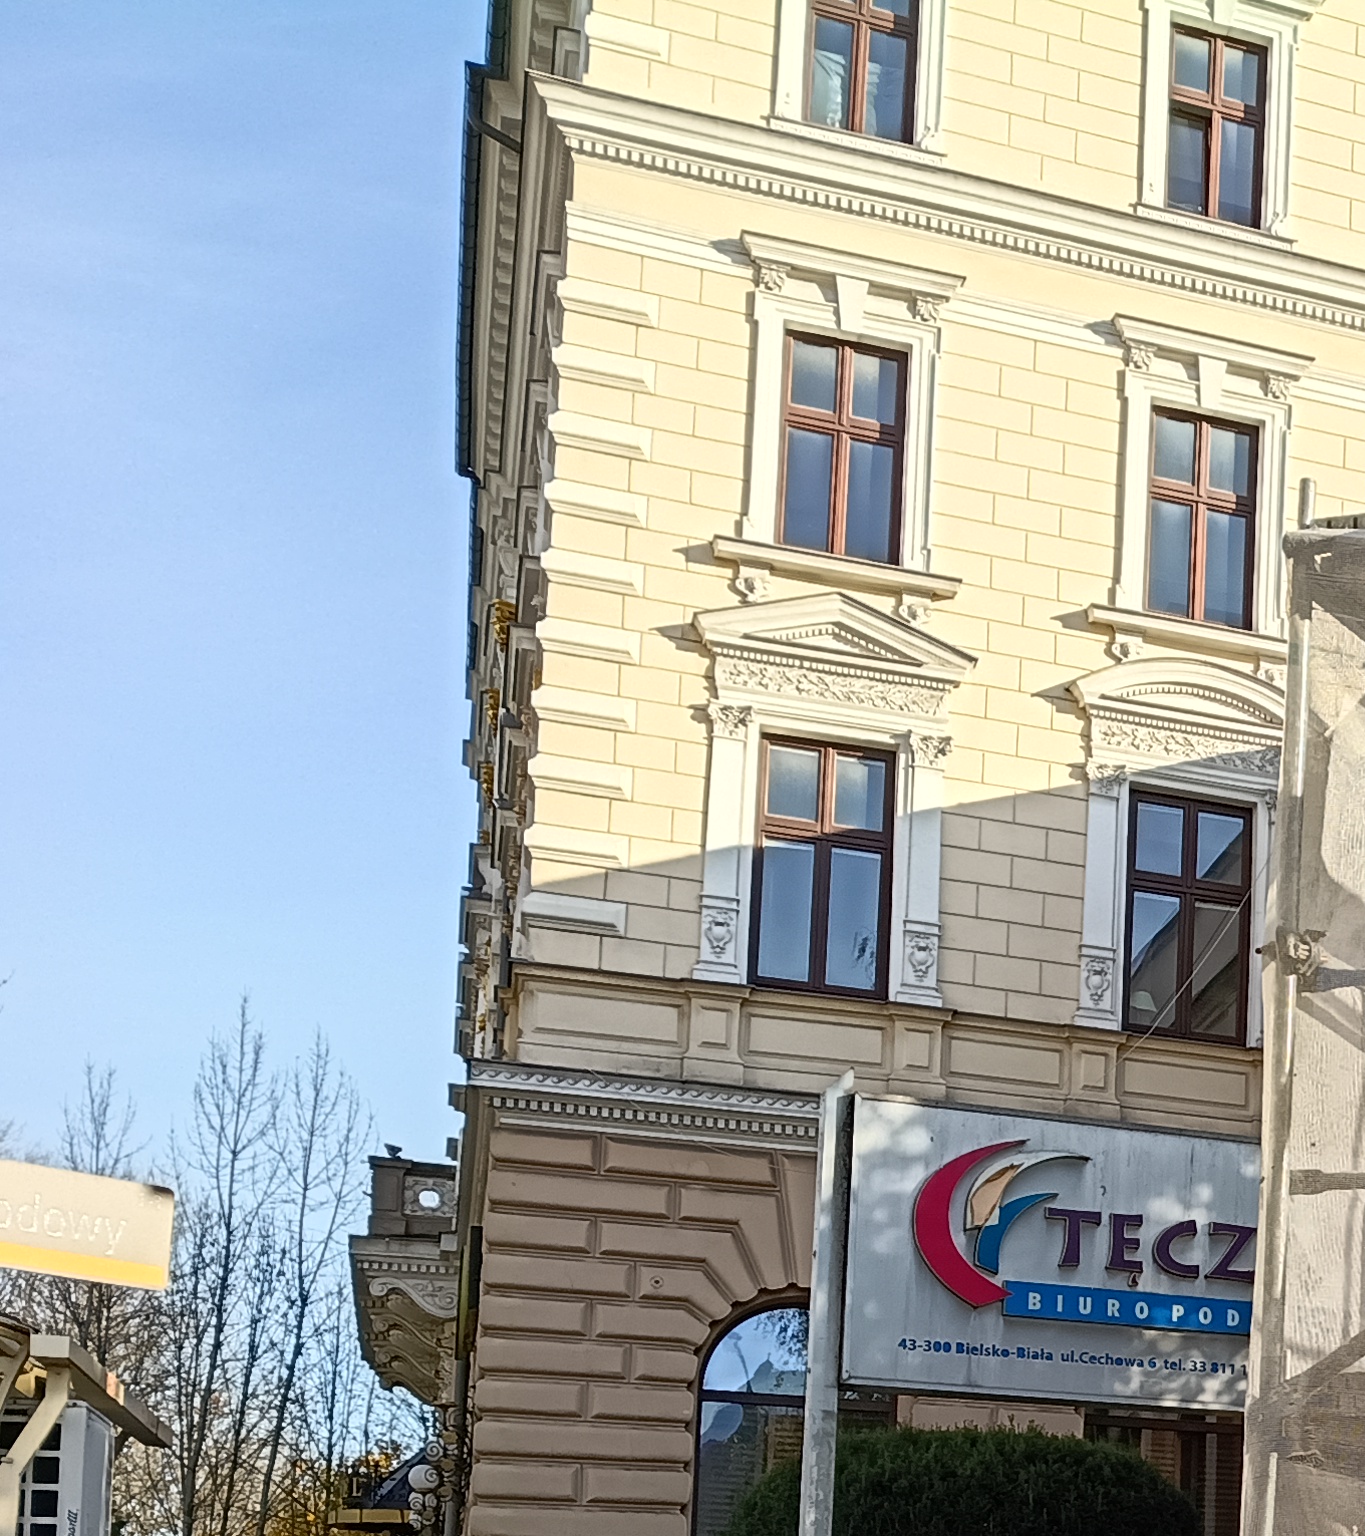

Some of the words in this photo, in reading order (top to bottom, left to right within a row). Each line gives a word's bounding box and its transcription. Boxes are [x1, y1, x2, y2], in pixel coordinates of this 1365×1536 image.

[1028, 1291, 1150, 1320] BIURO
[1171, 1303, 1240, 1327] POD
[897, 1337, 952, 1353] 43-300
[955, 1341, 1054, 1362] Bielsko-Biała
[1147, 1357, 1157, 1369] 6
[1163, 1358, 1186, 1372] tel.
[1189, 1360, 1207, 1373] 33
[1210, 1362, 1236, 1375] 811
